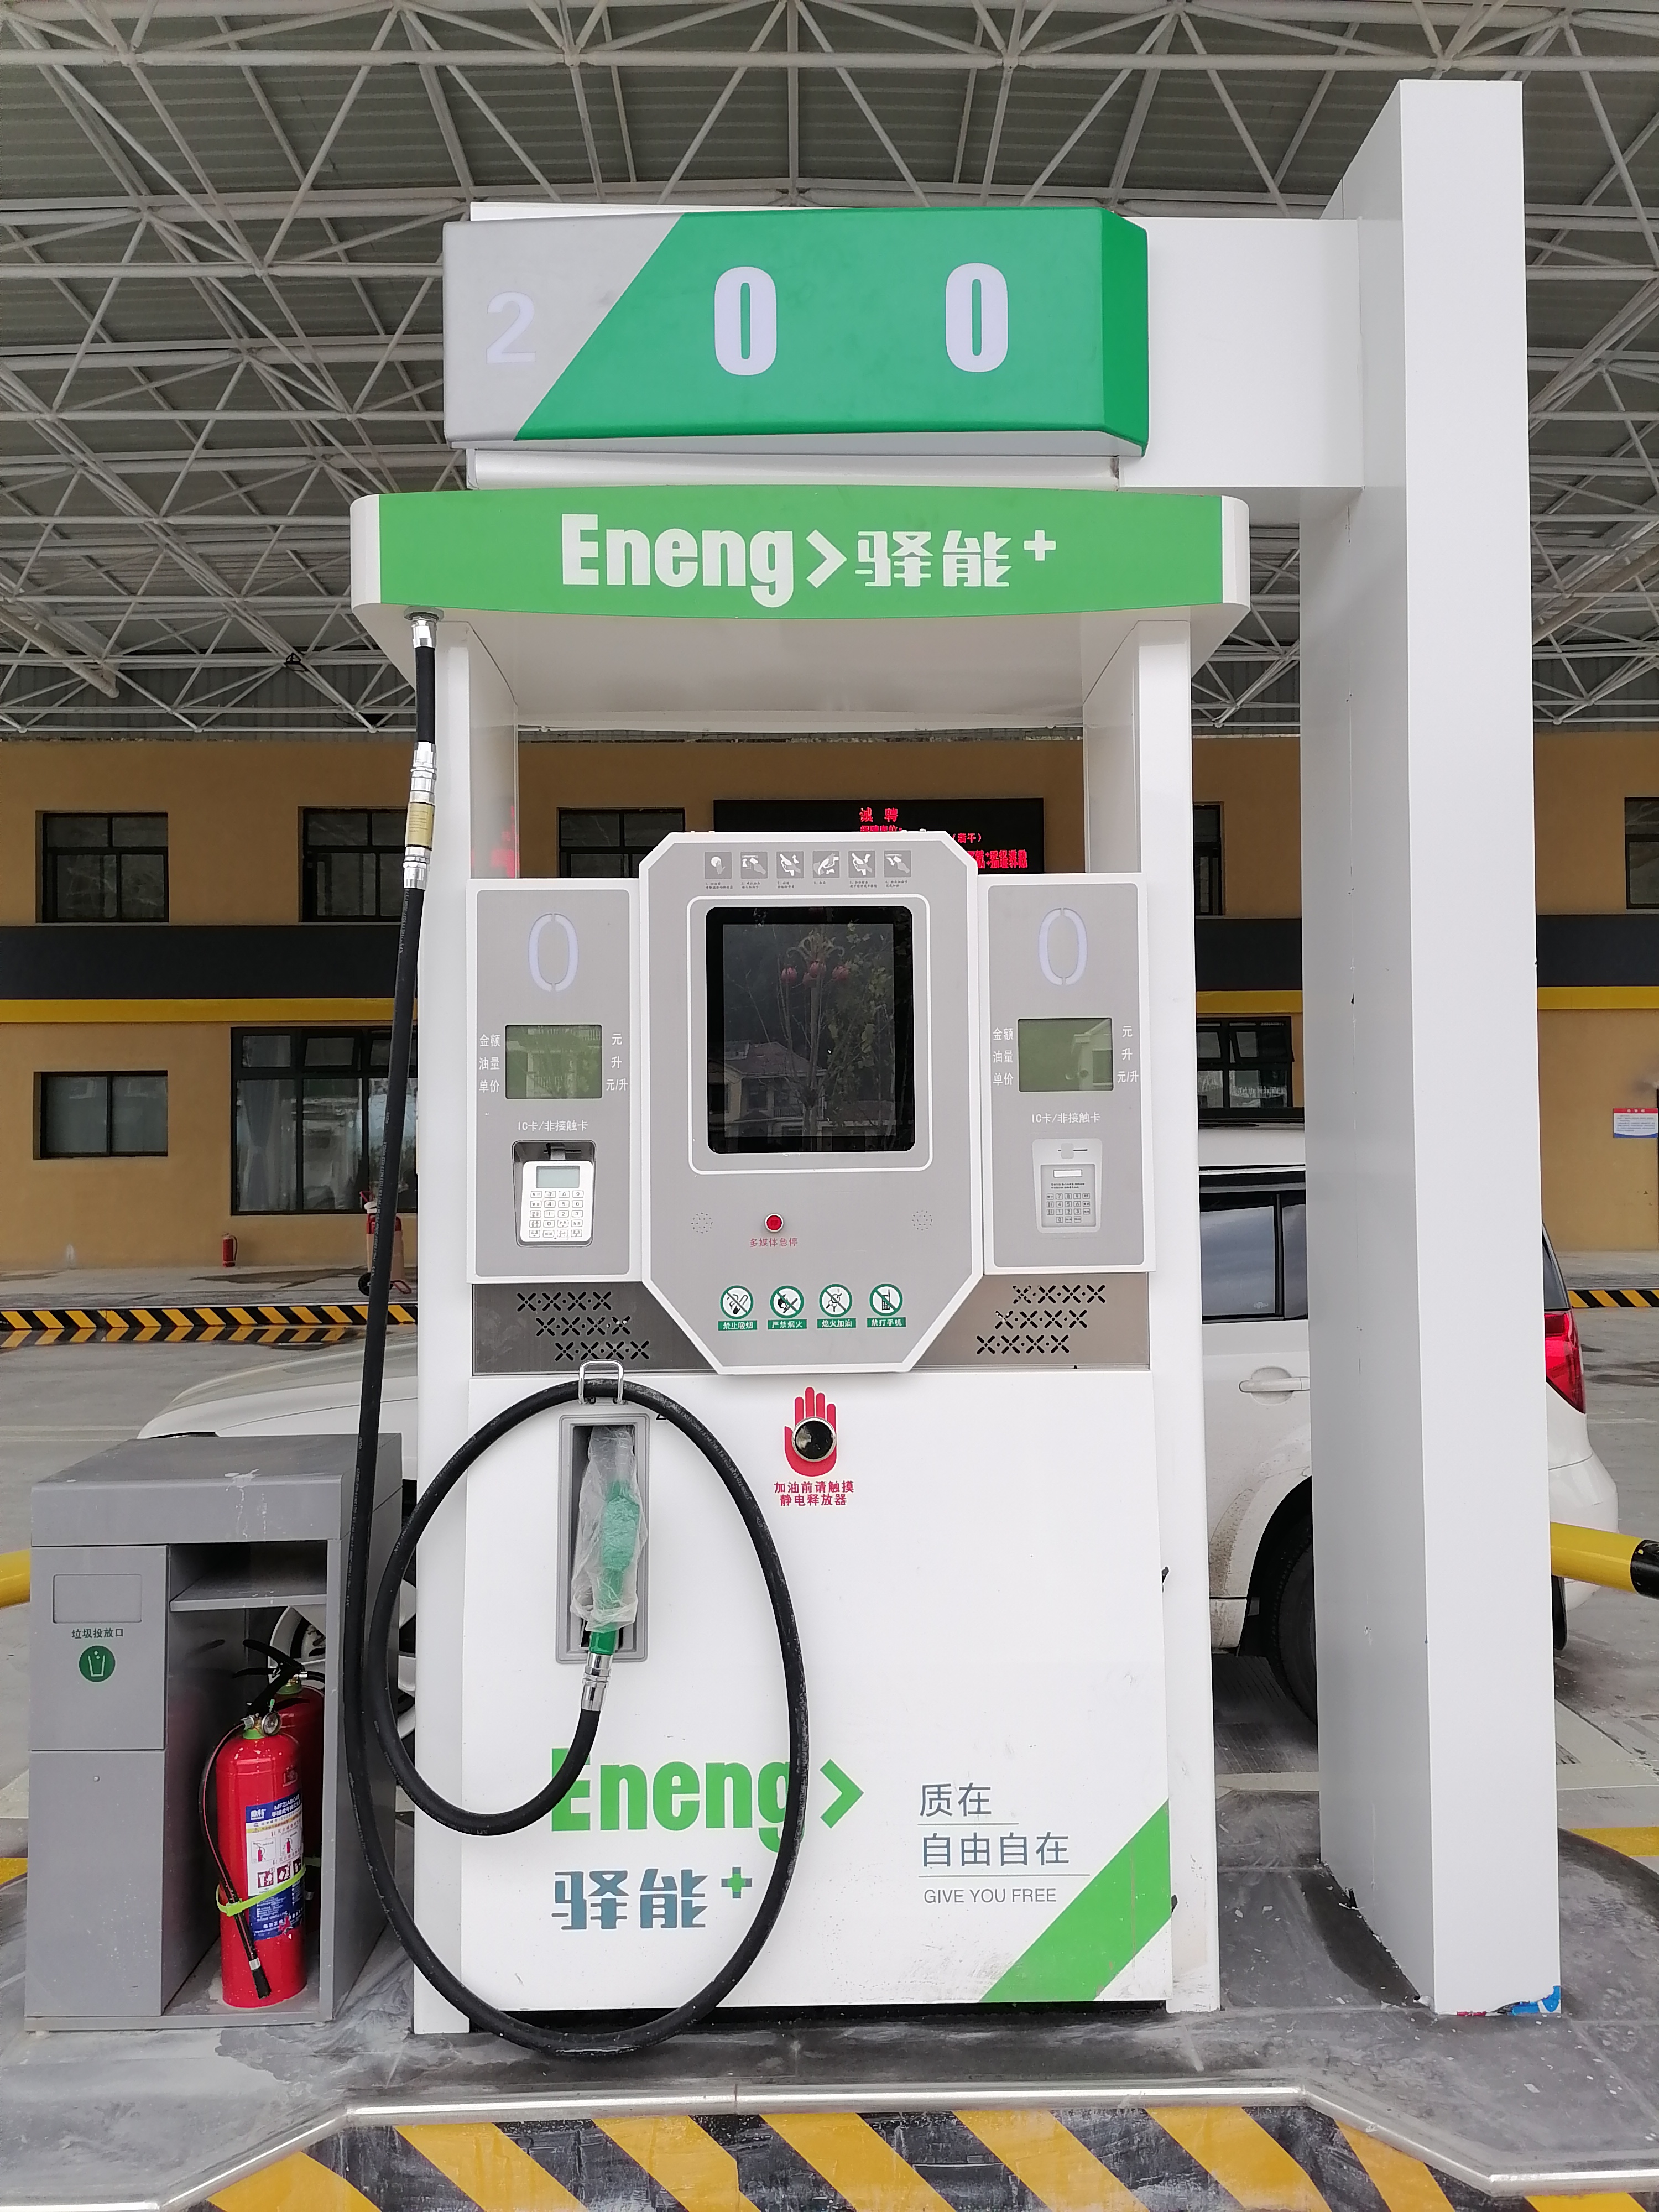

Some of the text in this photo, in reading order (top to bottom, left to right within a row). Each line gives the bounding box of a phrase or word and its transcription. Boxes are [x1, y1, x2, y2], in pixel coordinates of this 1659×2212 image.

[714, 265, 778, 376] 0
[945, 263, 1009, 373] 0
[485, 290, 537, 364] 2
[561, 513, 794, 608] Eneng
[528, 913, 579, 993] 0
[1038, 907, 1088, 986] 0
[993, 1027, 1014, 1041] 金额
[1121, 1025, 1133, 1038] 元
[479, 1034, 500, 1048] 金额
[611, 1033, 623, 1046] 元
[993, 1050, 1014, 1064] 油量
[1121, 1048, 1133, 1061] 升
[479, 1056, 500, 1071] 油量
[611, 1056, 622, 1070] 升
[993, 1072, 1014, 1086] 单价
[1117, 1070, 1139, 1083] 元/升
[479, 1079, 500, 1093] 单价
[606, 1078, 628, 1092] 元/升
[1031, 1112, 1100, 1124] IC卡/非接触卡
[518, 1119, 588, 1133] IC卡/非接触卡
[749, 1237, 798, 1248] 多媒体急停
[722, 1321, 754, 1330] 禁止吸烟
[771, 1320, 803, 1329] 严禁烟火
[821, 1319, 852, 1328] 熄火加油
[870, 1318, 902, 1327] 禁打手机
[774, 1481, 854, 1494] 加油前请触摸
[779, 1494, 847, 1506] 静电释放器
[71, 1628, 124, 1639] 垃圾投放口
[551, 1747, 805, 1853] Eneng
[919, 1782, 992, 1818] 质在
[923, 1831, 1070, 1866] 自由自在
[924, 1888, 1057, 1903] GIVE YOU FREE
